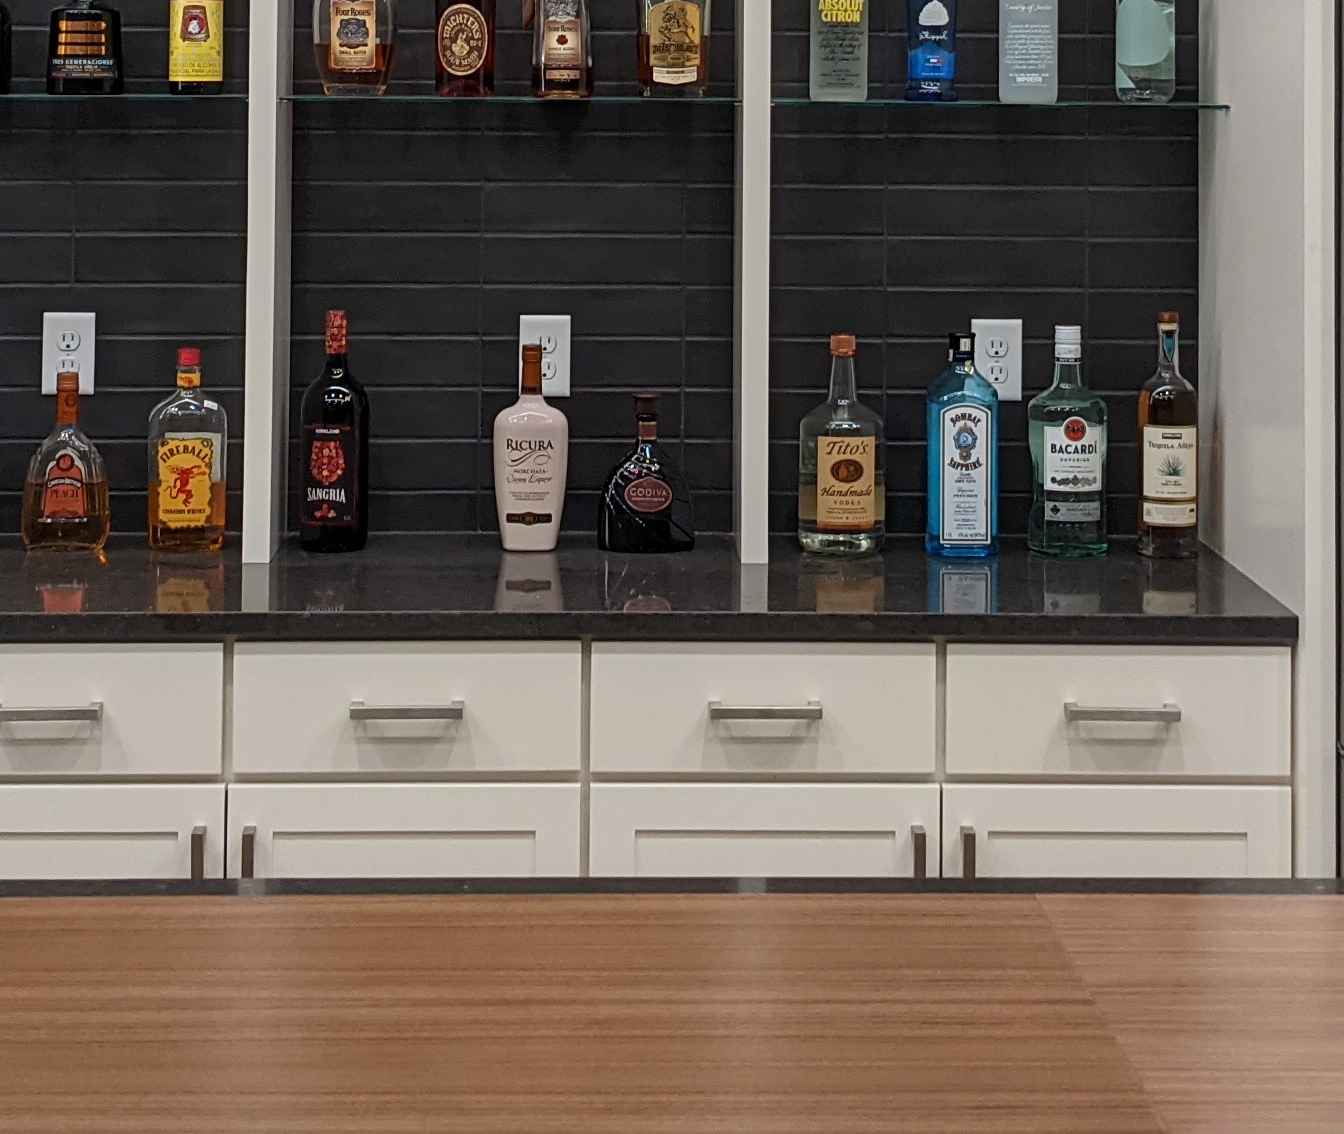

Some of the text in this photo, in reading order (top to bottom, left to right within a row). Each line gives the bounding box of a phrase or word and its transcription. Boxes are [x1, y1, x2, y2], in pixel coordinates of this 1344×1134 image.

[821, 10, 861, 23] CITRON
[949, 412, 983, 428] BOMBAY
[506, 438, 555, 452] RICURA
[825, 440, 869, 456] Tito's
[1050, 440, 1099, 455] BACARDÍ
[159, 444, 210, 464] FIREBALL
[947, 456, 984, 472] SAPPHIRE
[307, 487, 346, 503] SANGRIA
[629, 487, 667, 497] GODIVA
[820, 484, 873, 497] Handmade
